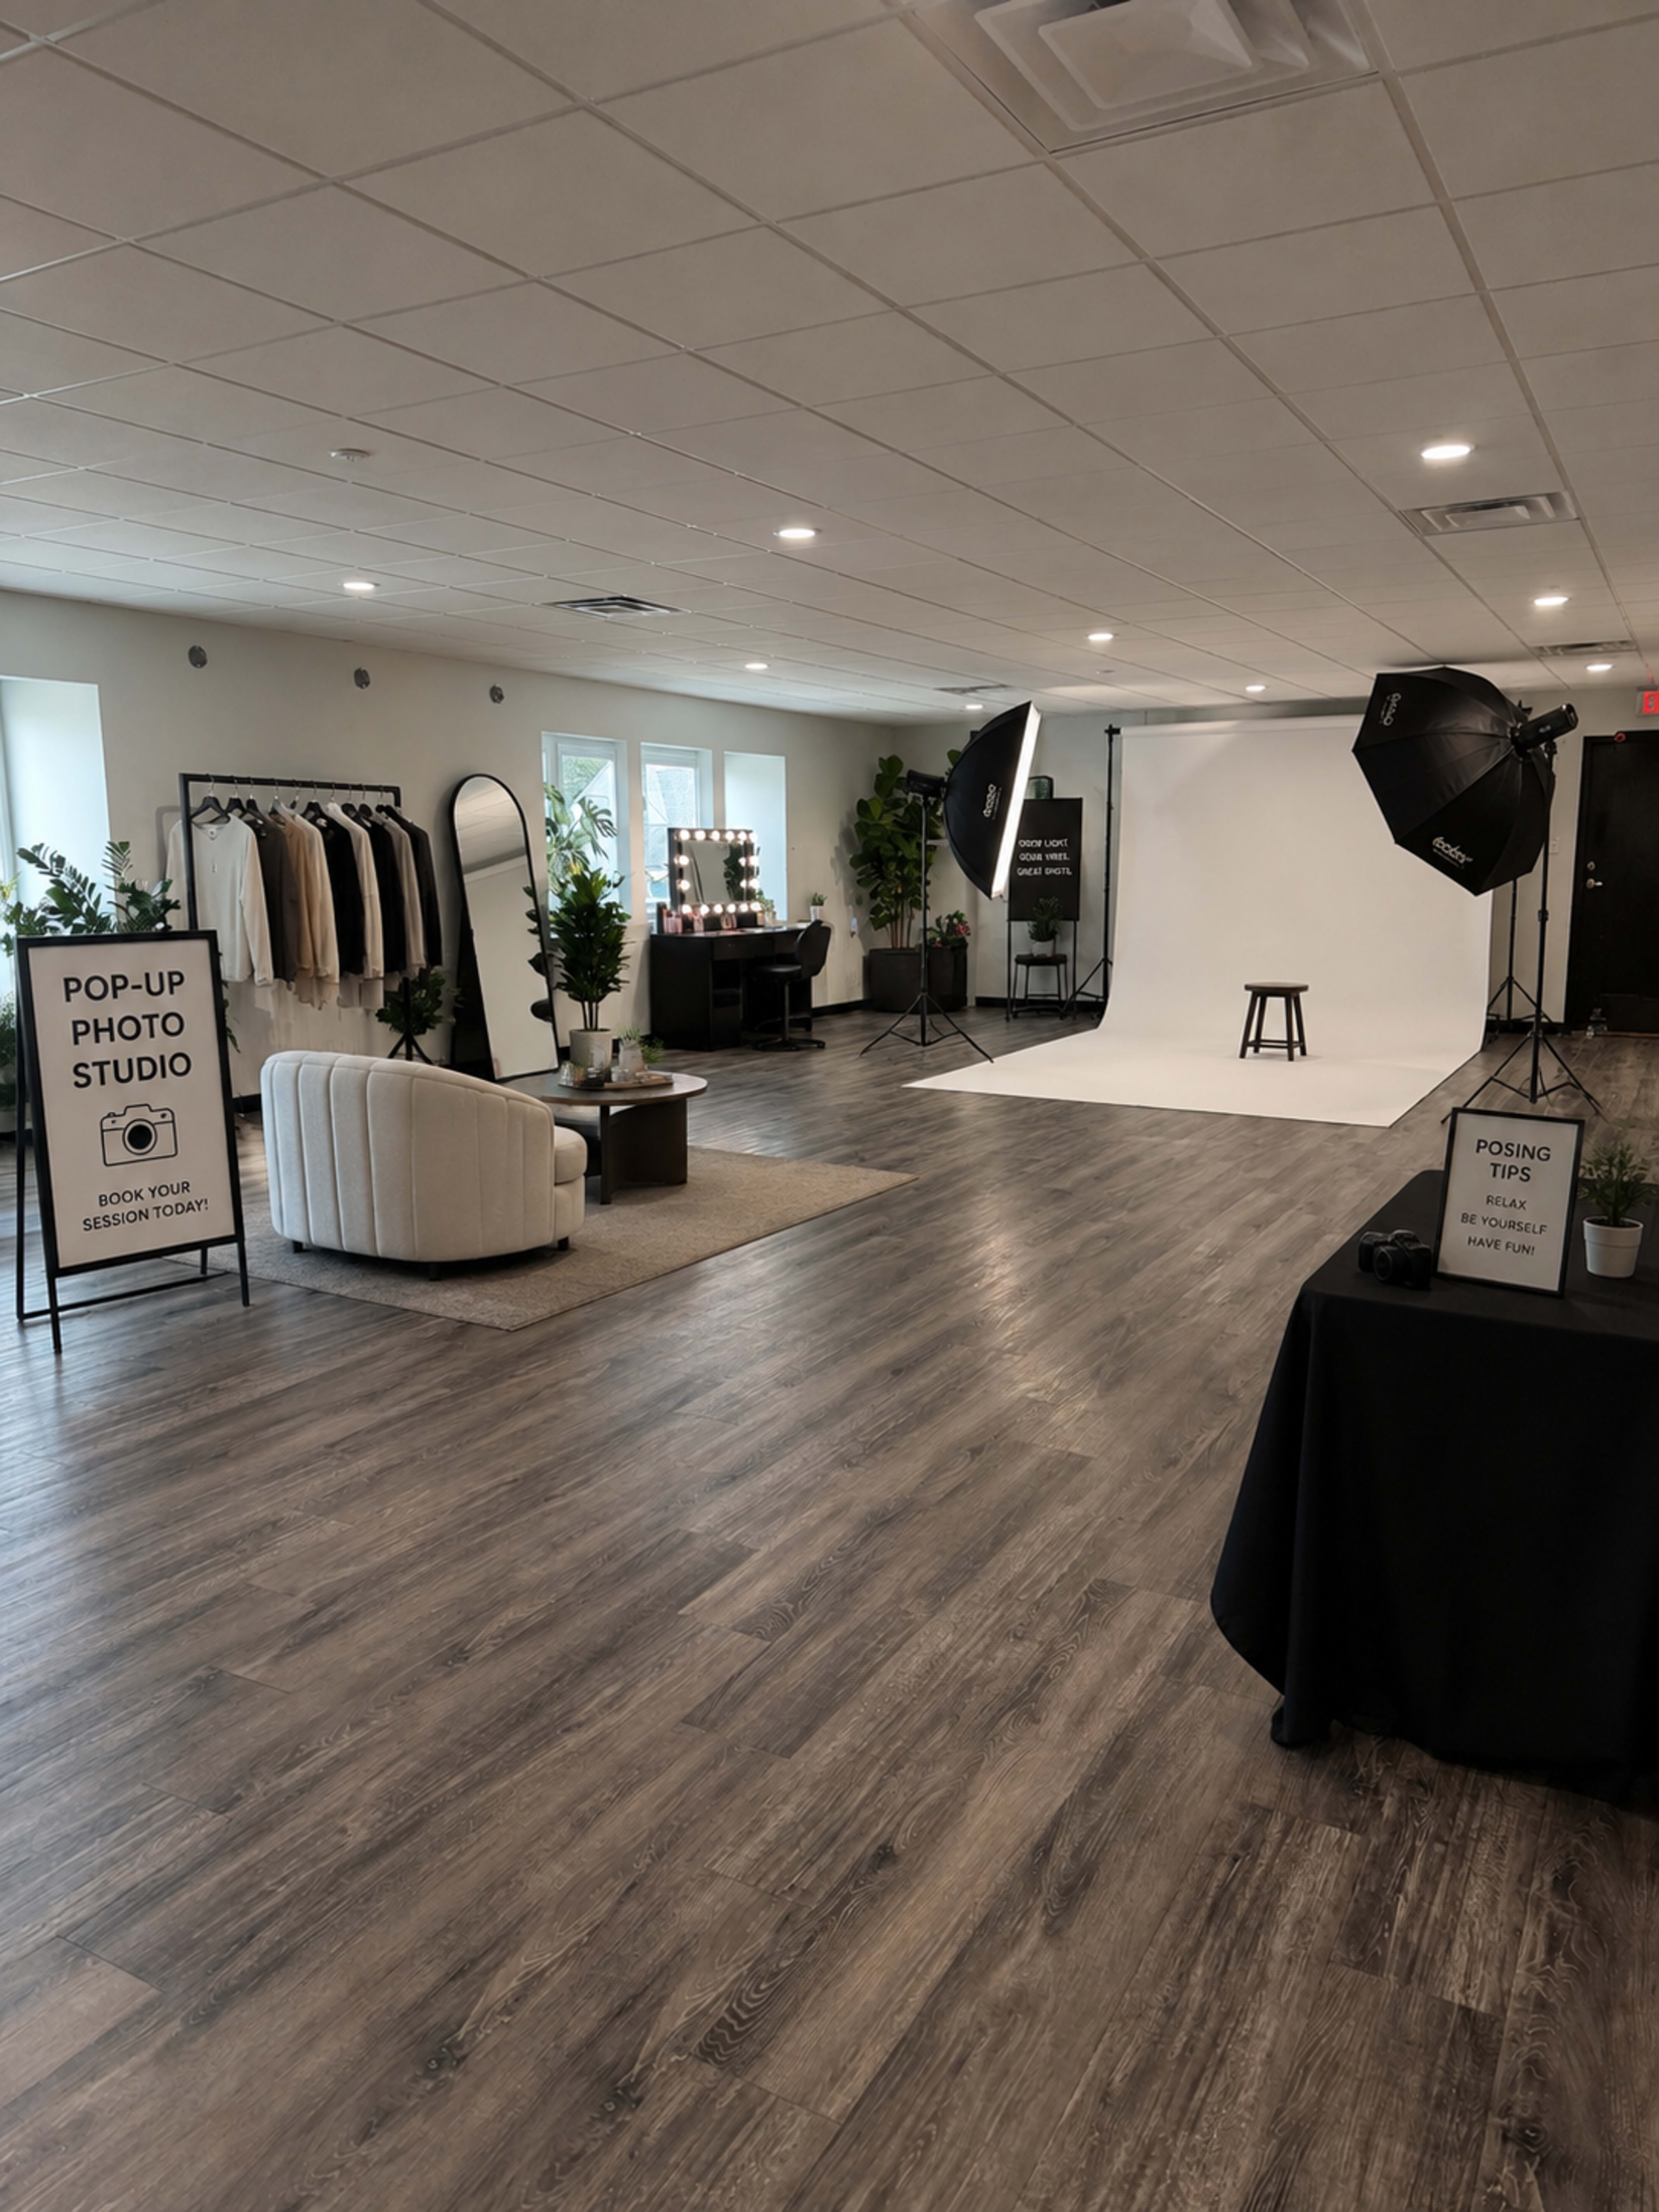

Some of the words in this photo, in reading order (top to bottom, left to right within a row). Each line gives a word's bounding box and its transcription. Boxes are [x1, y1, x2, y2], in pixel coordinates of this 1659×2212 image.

[63, 971, 184, 1002] POP-UP
[72, 1012, 184, 1046] PHOTO
[73, 1052, 191, 1088] STUDIO
[1476, 1139, 1551, 1162] POSING
[1490, 1162, 1532, 1182] TIPS
[99, 1188, 144, 1207] BOOK
[148, 1181, 190, 1198] YOUR
[1486, 1195, 1527, 1210] RELAX
[83, 1208, 149, 1231] SESSION
[153, 1198, 208, 1218] TODAY!
[1461, 1212, 1477, 1225] BE
[1481, 1216, 1548, 1235] YOURSELF
[1468, 1236, 1501, 1250] HAVE
[1505, 1241, 1535, 1255] FUN!
